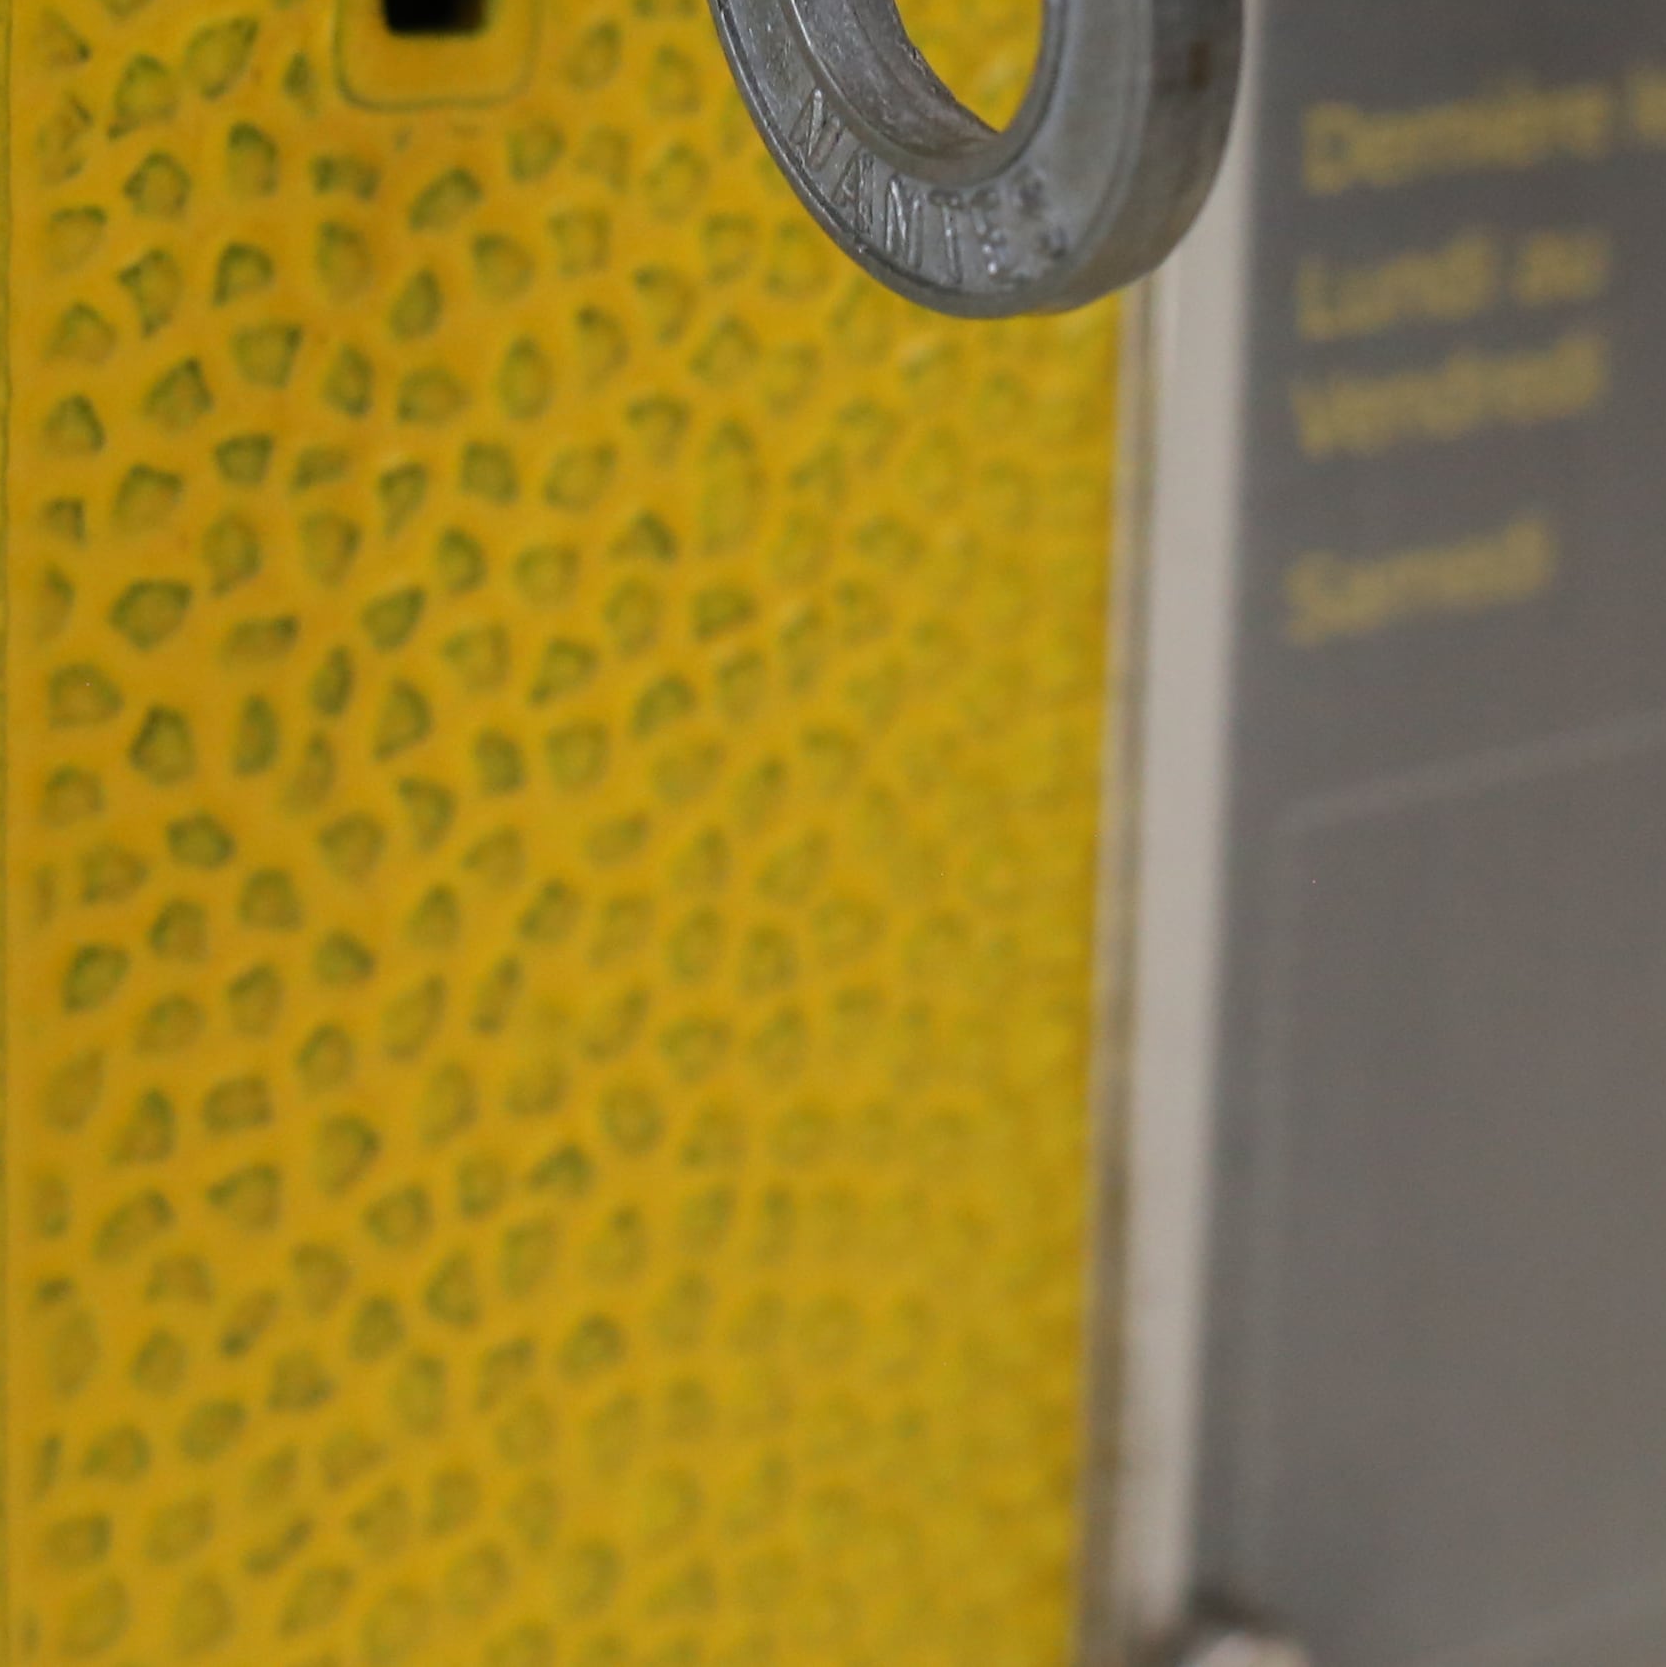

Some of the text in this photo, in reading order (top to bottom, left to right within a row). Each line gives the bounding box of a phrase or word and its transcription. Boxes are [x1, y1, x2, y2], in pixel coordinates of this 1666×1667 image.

[1301, 72, 1613, 192] Dernière
[1295, 230, 1610, 338] Lundi au
[1291, 337, 1609, 454] Vendredi
[1285, 514, 1555, 644] Samedi
